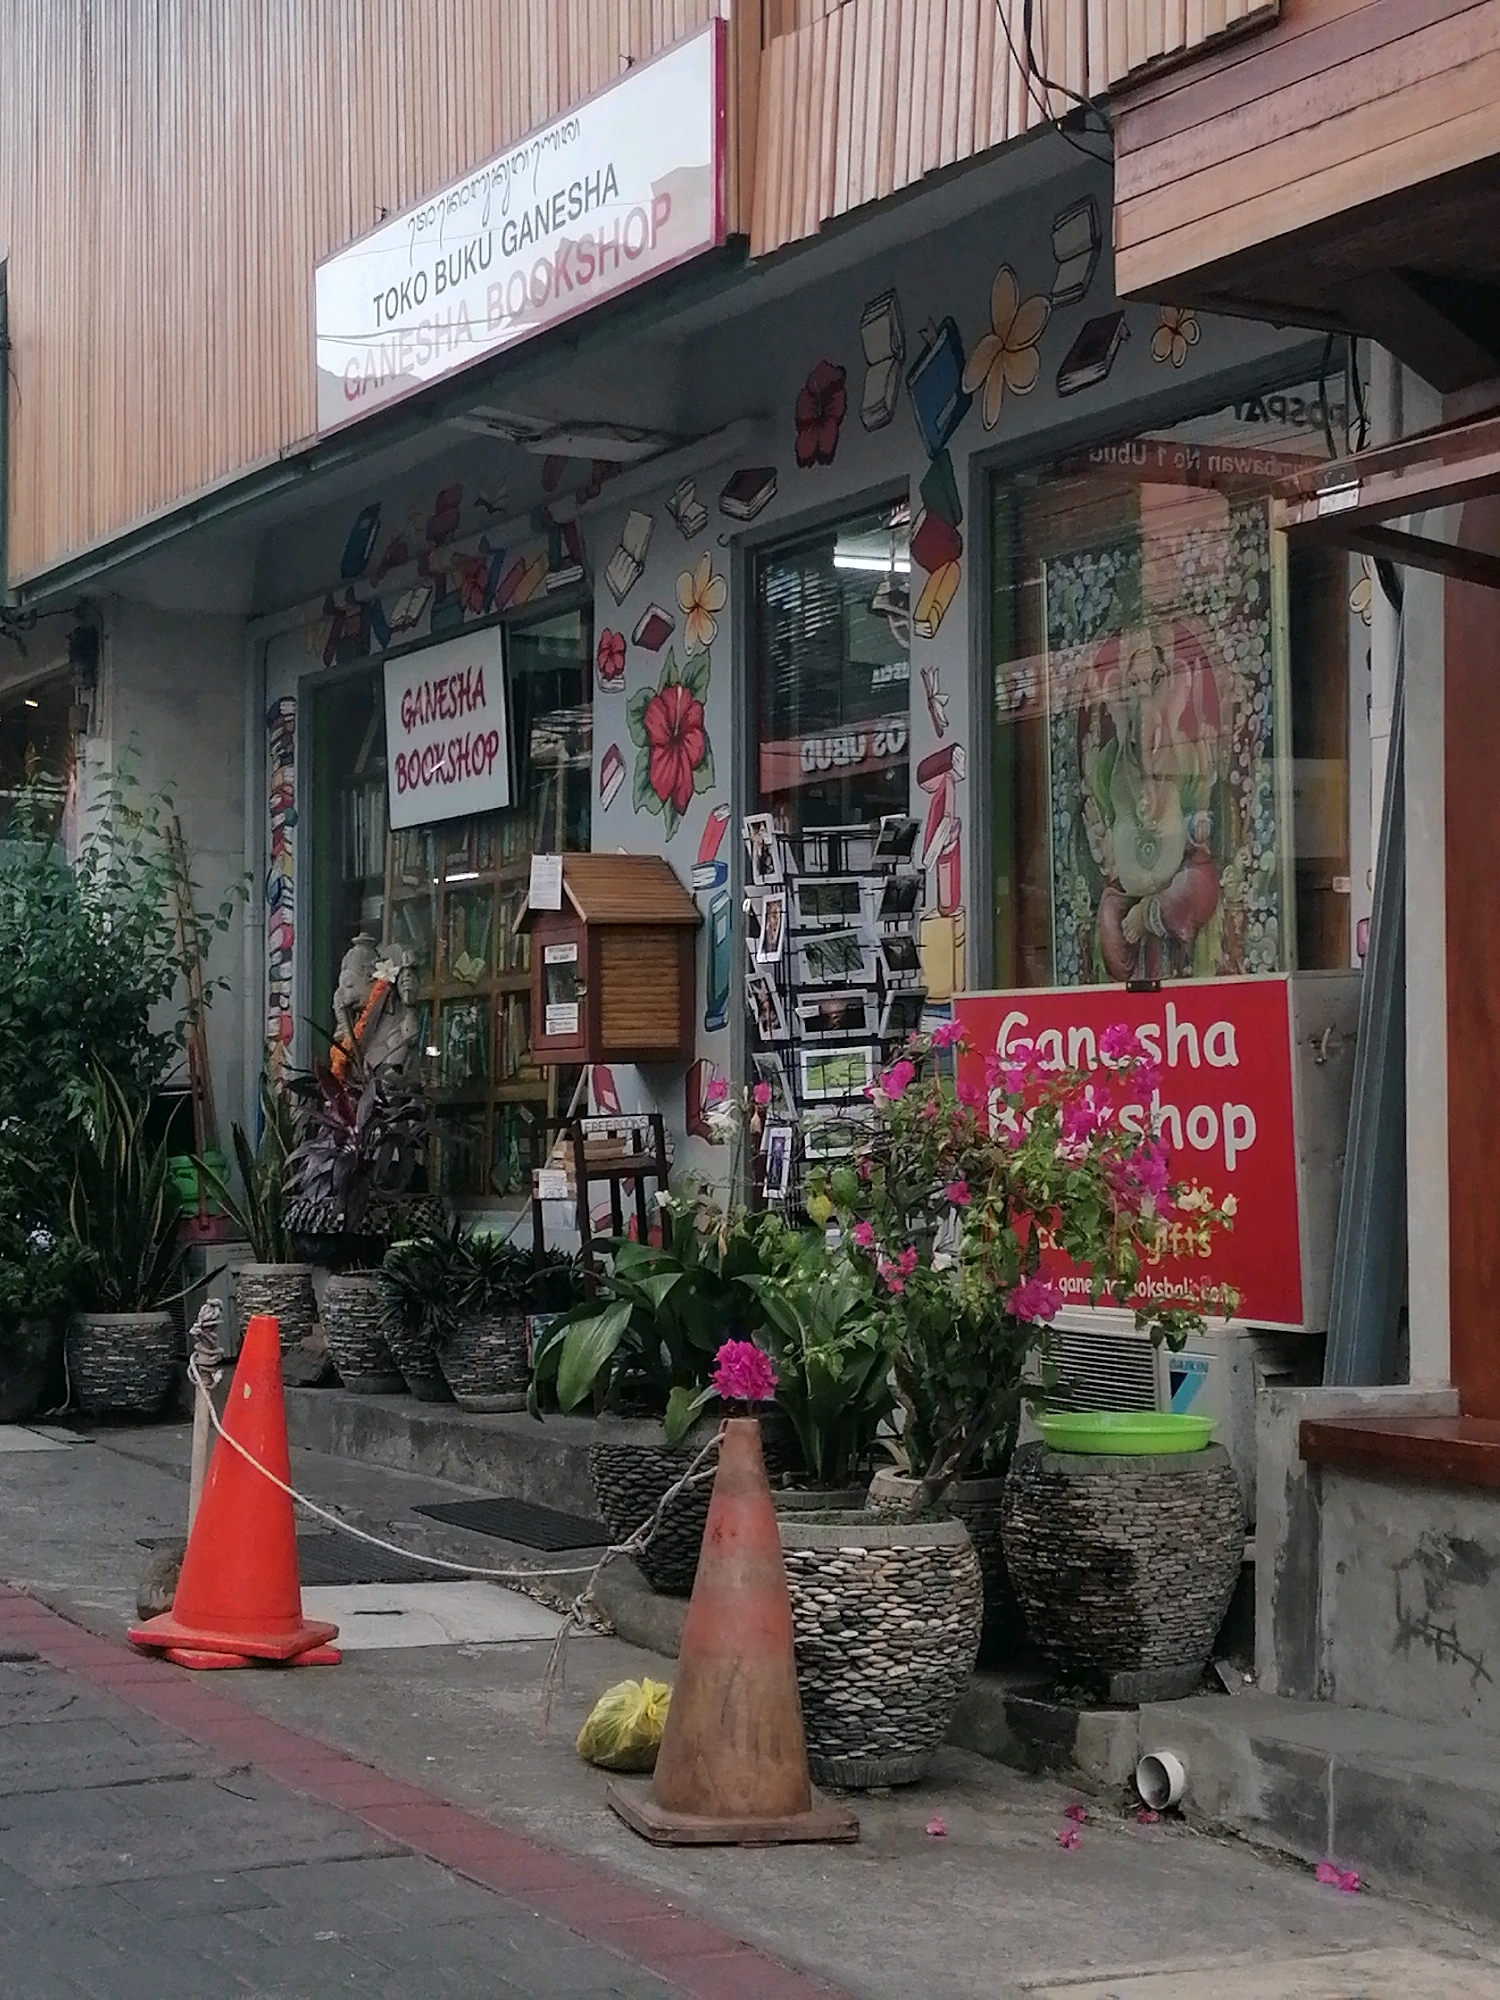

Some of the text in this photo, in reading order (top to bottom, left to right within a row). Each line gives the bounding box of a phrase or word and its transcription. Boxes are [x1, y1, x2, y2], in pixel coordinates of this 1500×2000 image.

[373, 163, 620, 328] TOKO BUKU GANESHA
[343, 192, 672, 402] GANESHA BOOKSHOP
[400, 665, 486, 735] GANESHA
[395, 730, 499, 795] BOOKSHOP
[585, 1120, 615, 1133] FREE
